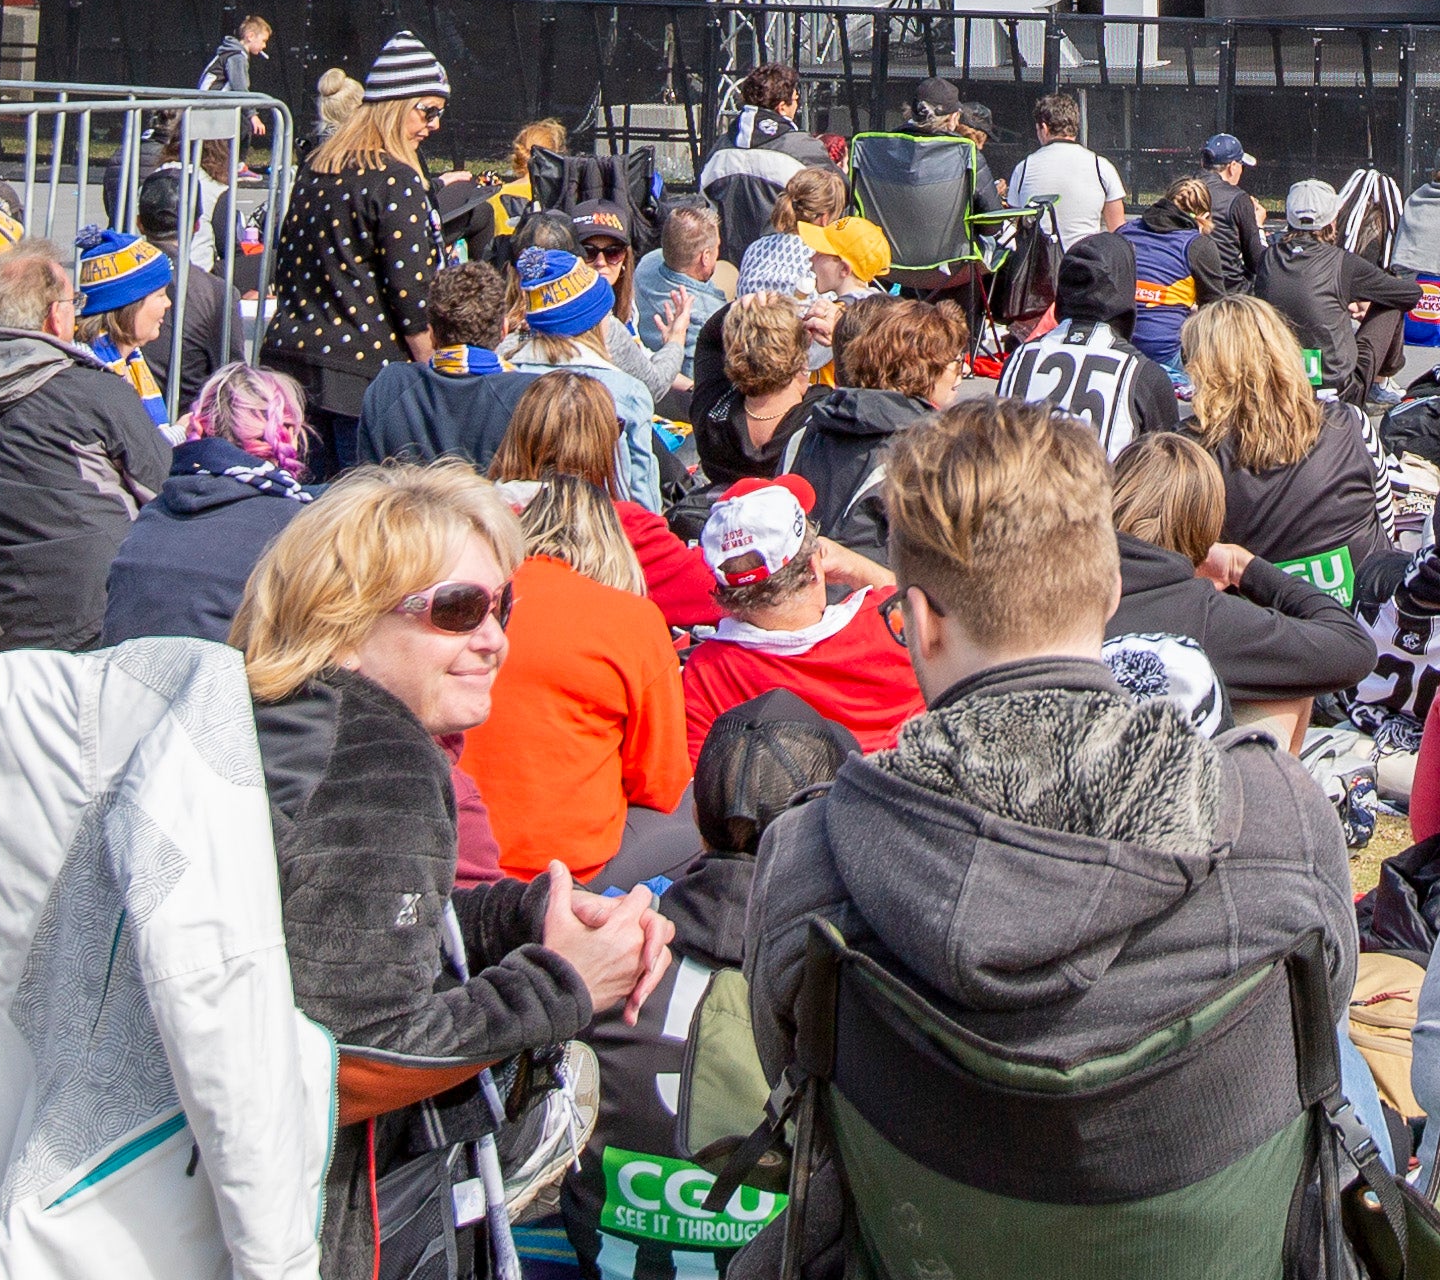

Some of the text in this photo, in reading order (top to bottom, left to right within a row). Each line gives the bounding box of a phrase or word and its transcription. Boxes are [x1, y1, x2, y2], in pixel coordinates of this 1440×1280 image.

[1417, 302, 1440, 311] ACKS
[618, 1160, 776, 1222] CGU
[616, 1205, 767, 1242] SEE IT THROUG
